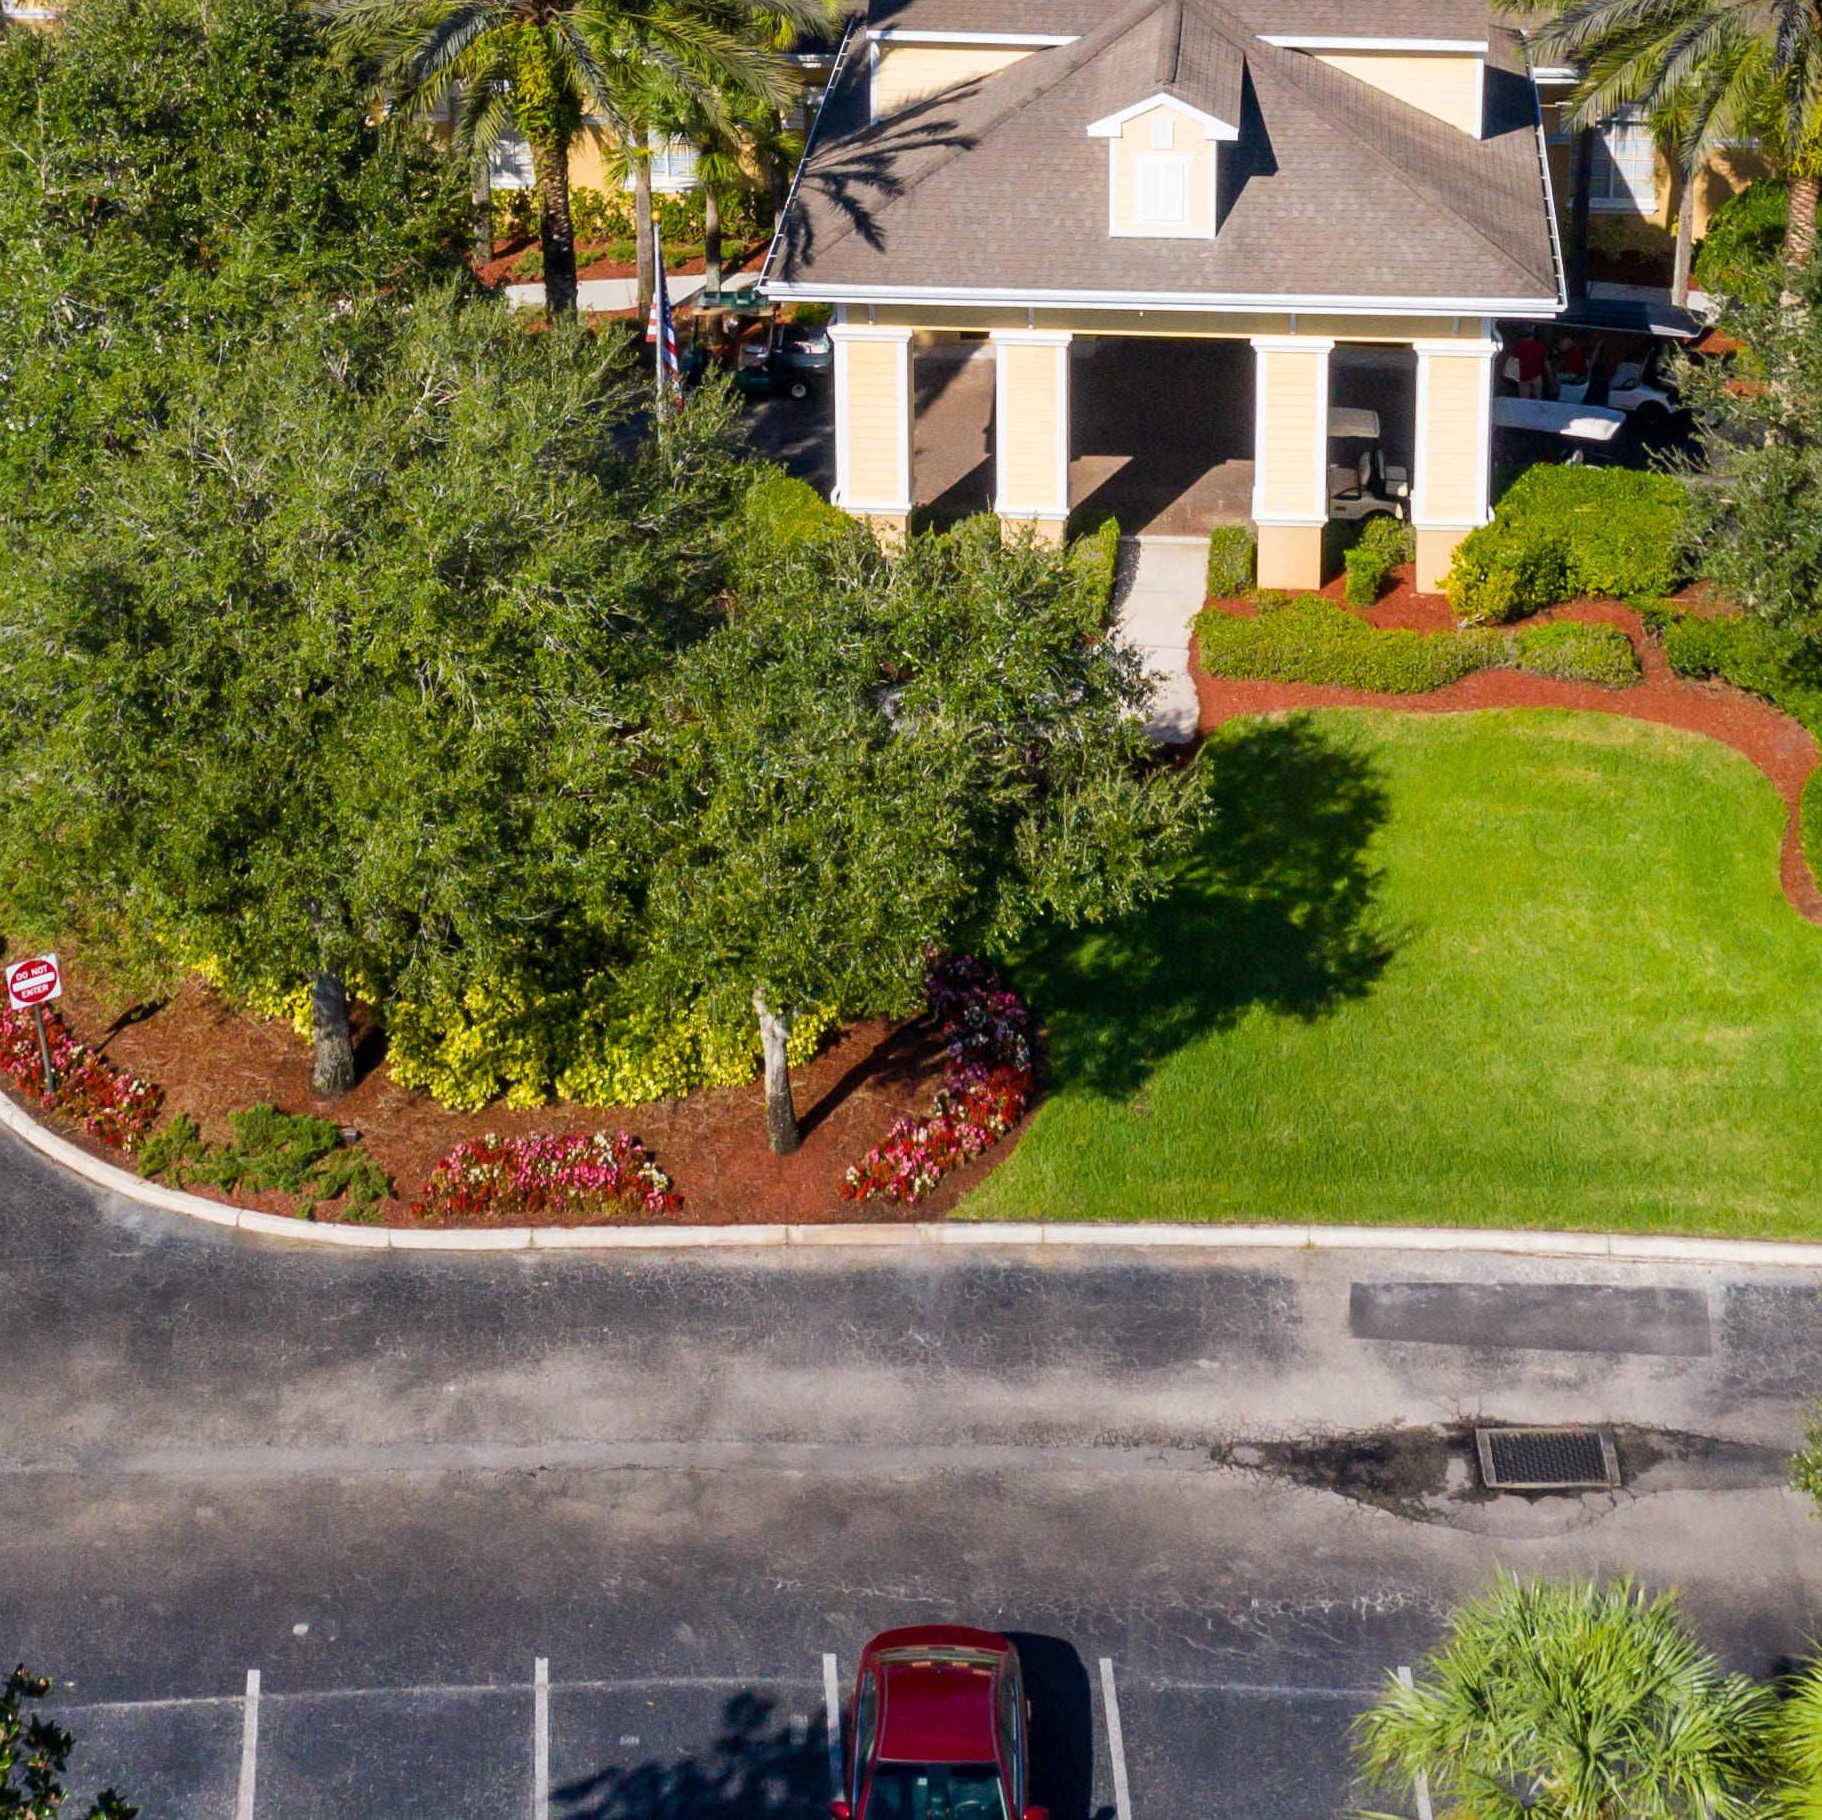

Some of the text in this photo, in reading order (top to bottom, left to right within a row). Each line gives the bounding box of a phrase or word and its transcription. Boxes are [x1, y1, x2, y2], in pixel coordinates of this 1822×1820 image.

[15, 964, 47, 981] DO NOT
[21, 984, 49, 999] ENTER
